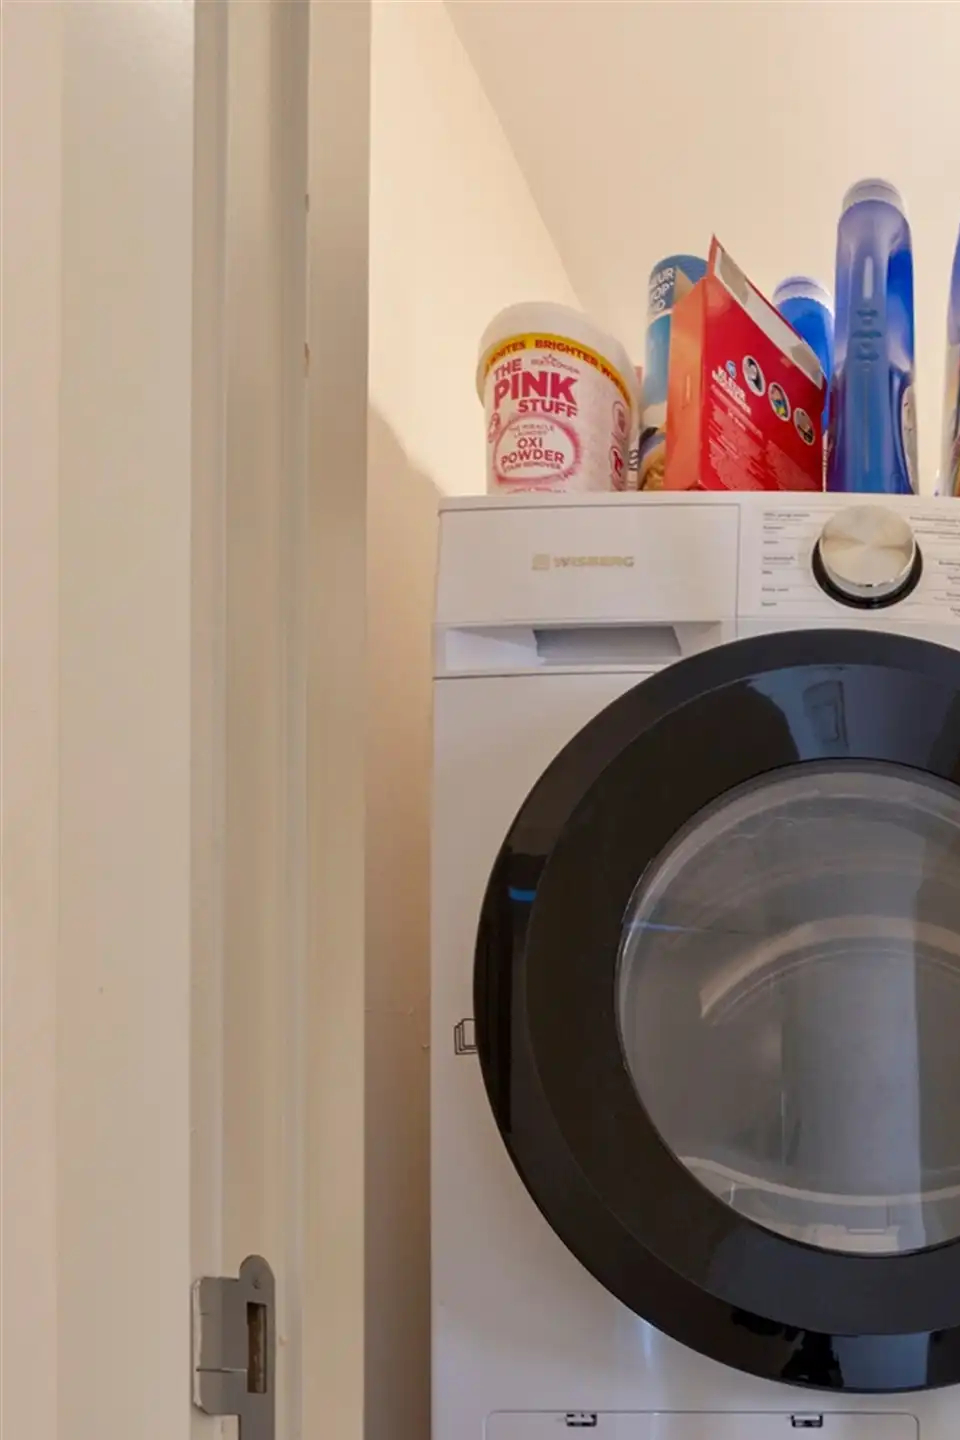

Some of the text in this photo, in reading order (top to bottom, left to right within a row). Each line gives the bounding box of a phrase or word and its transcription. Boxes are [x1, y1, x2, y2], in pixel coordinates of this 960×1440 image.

[535, 339, 598, 367] BRIGHTER
[493, 358, 522, 380] THE
[494, 371, 578, 410] PINK
[518, 399, 578, 418] STUFF
[517, 437, 543, 449] OXI
[500, 450, 565, 467] POWDER
[553, 555, 635, 568] WISBERG
